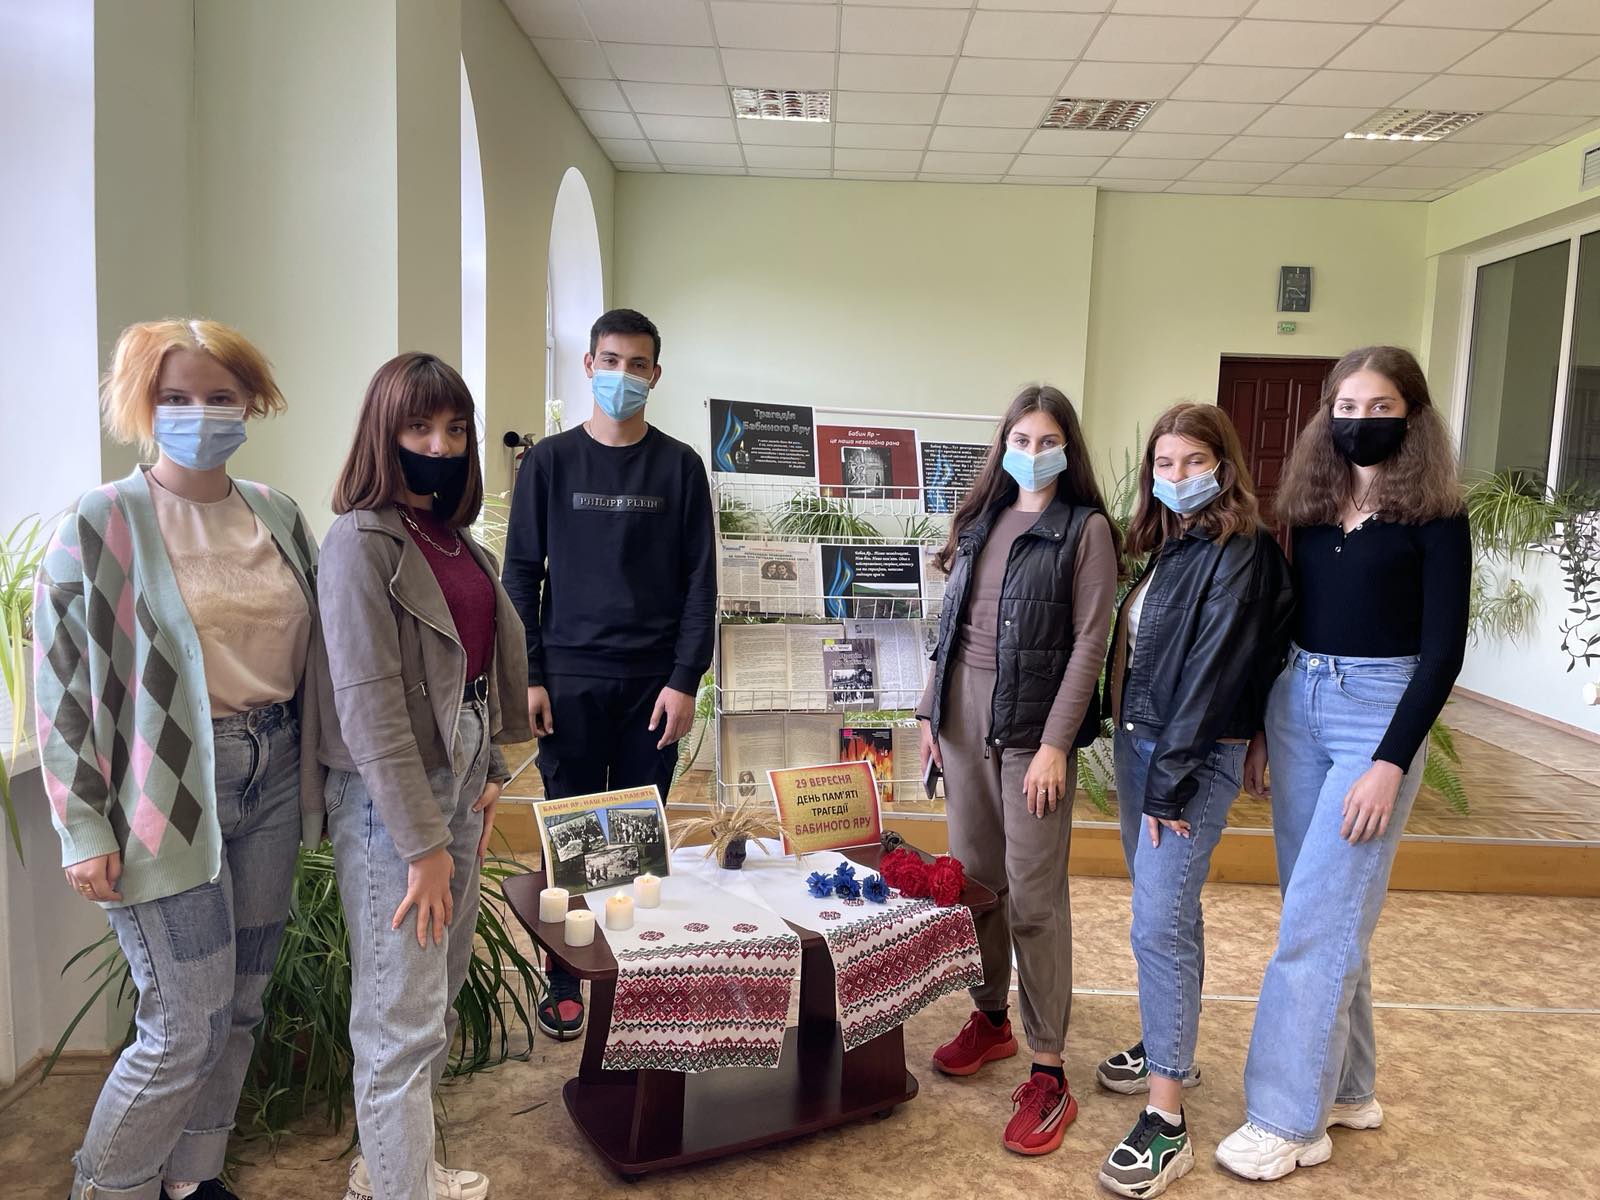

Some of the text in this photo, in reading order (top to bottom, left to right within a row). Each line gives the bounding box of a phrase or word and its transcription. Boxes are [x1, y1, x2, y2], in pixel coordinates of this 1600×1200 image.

[754, 408, 796, 421] Трагедія
[743, 421, 811, 435] Бабиного Яру
[580, 497, 658, 508] PHILIPP PLEIN
[795, 774, 853, 789] 29 ВЕРЕСНЯ
[797, 794, 821, 806] ДЕНЬ
[811, 802, 849, 817] ТРАГЕДІЇ
[795, 816, 871, 836] БАБИНОГО ЯРУ
